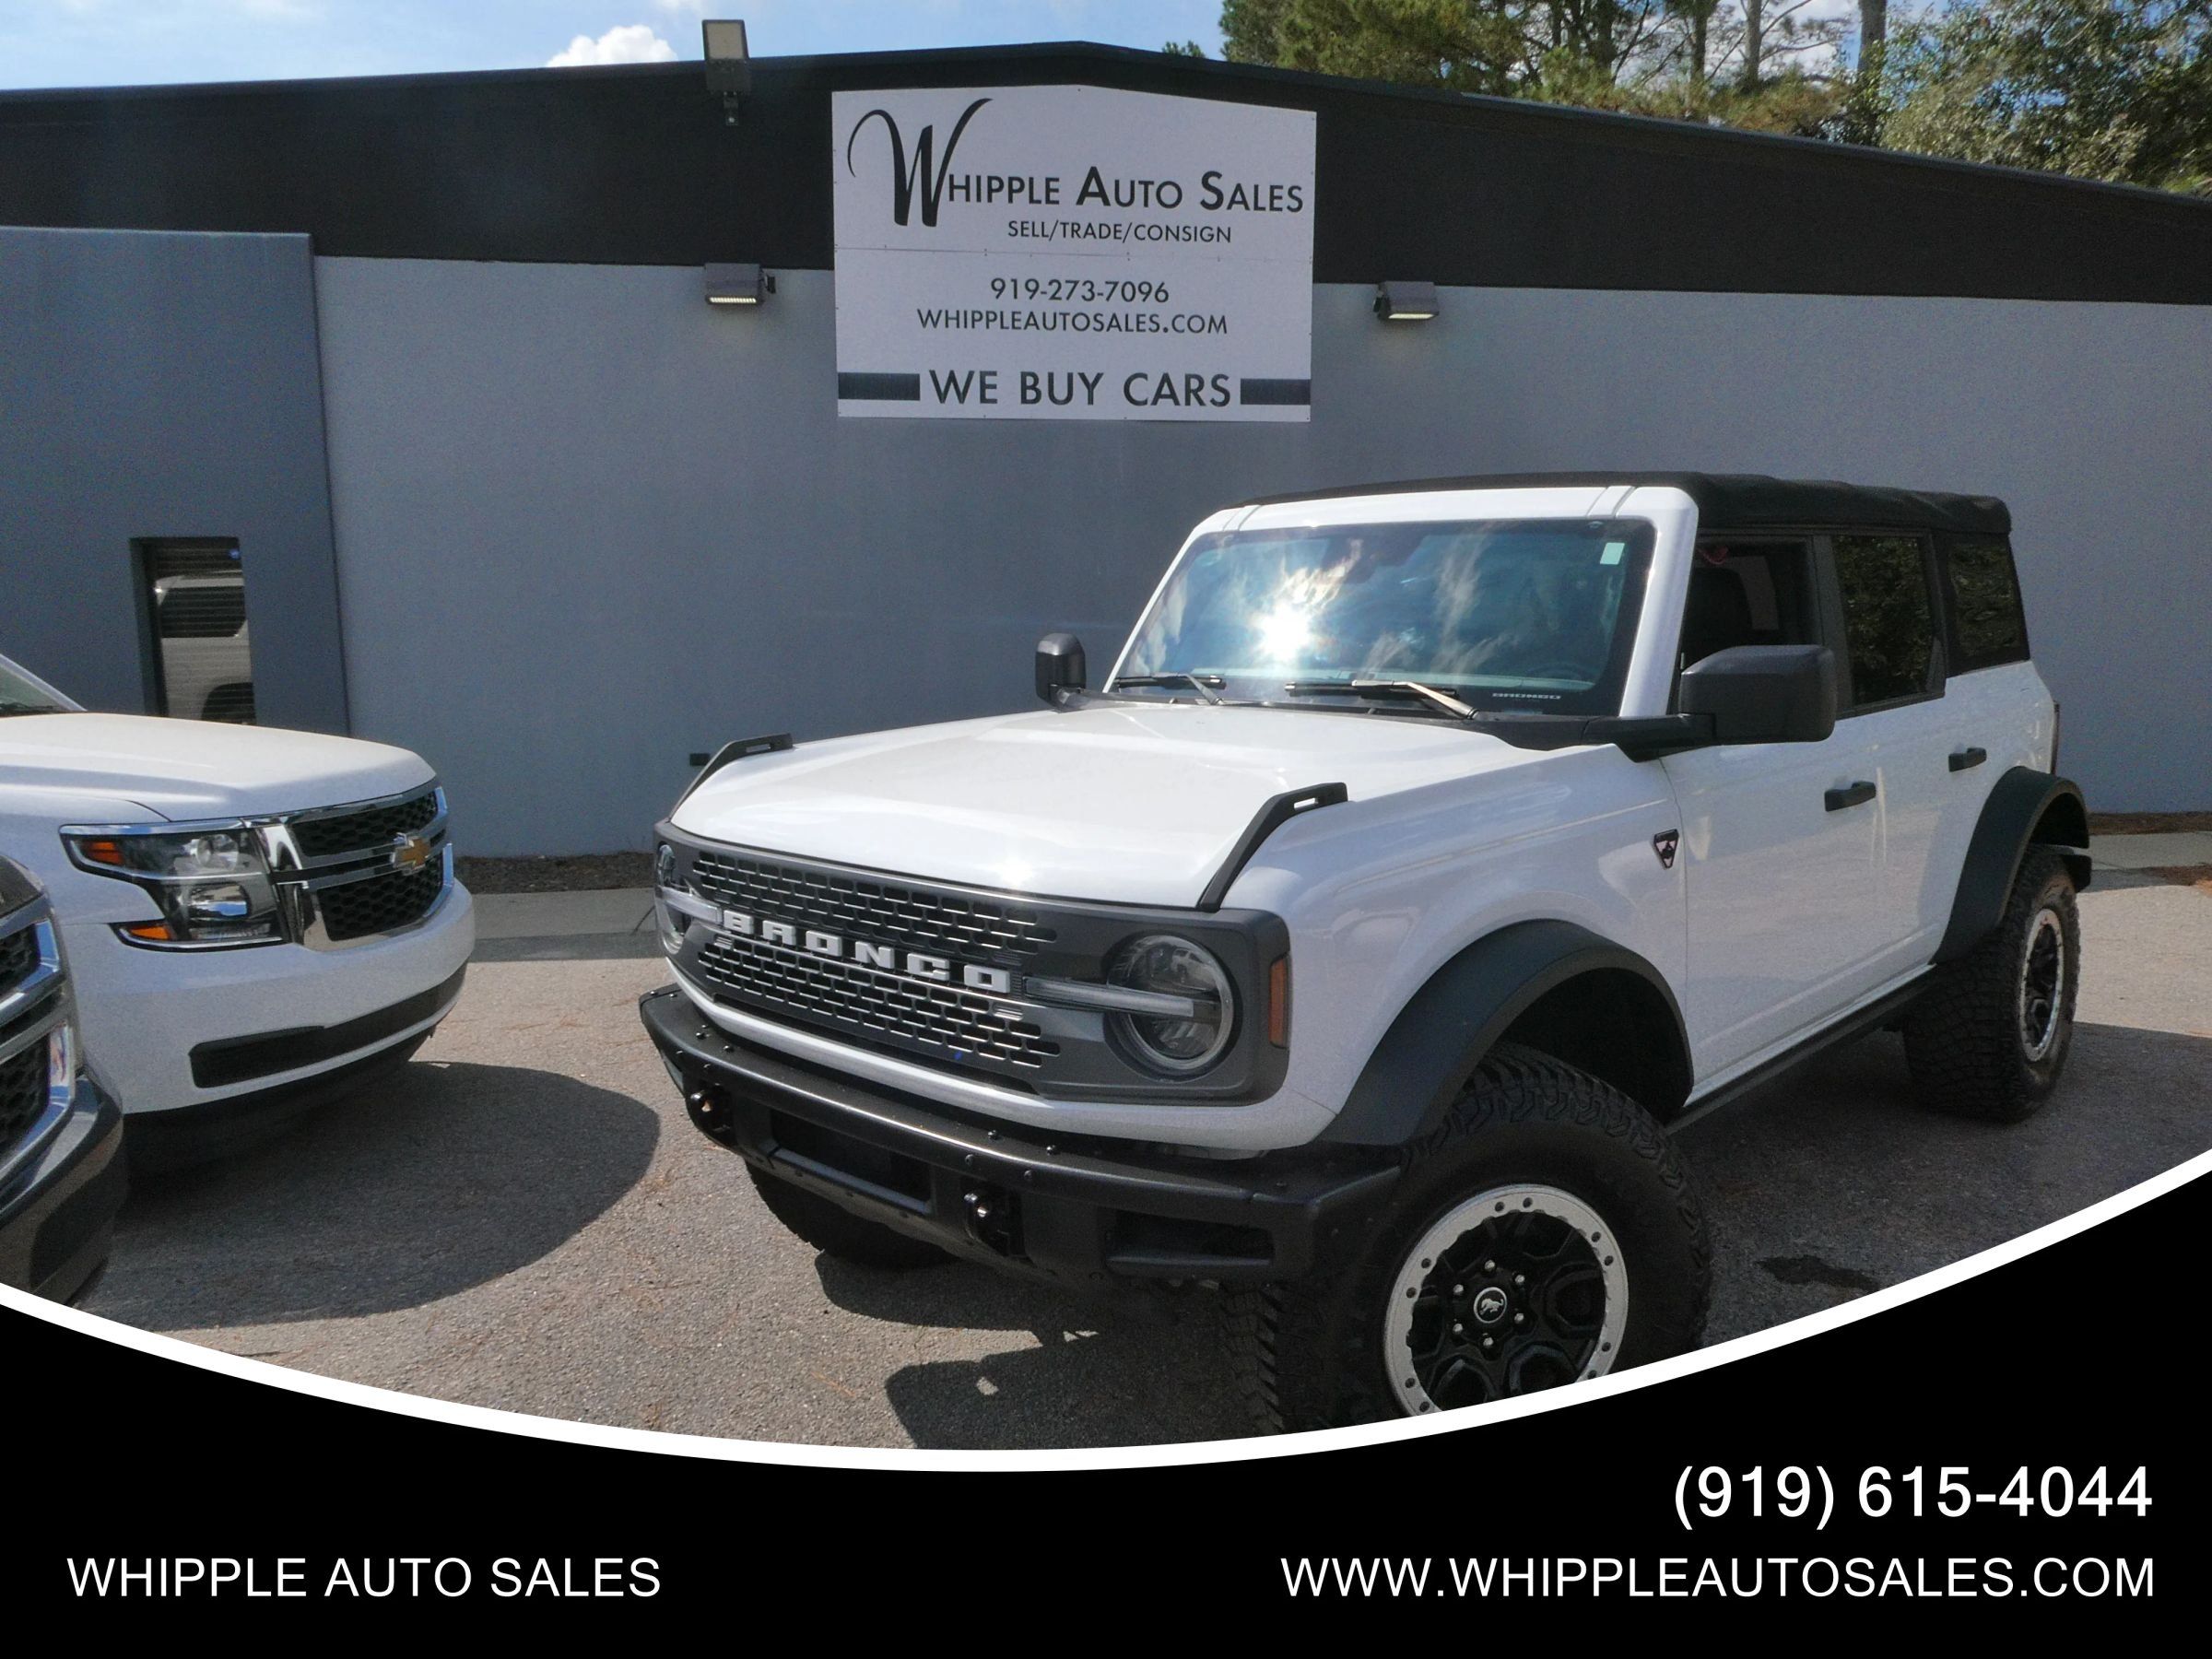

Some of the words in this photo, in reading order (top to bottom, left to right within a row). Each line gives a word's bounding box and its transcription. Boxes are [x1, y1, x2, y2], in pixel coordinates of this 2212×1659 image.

[847, 98, 1061, 228] WHIPPLE
[1076, 166, 1183, 210] AUTO
[1199, 171, 1304, 213] SALES
[1008, 219, 1231, 243] SELL/TRADE/CONSIGN
[991, 277, 1170, 303] 919-273-7096
[917, 308, 1228, 335] WHIPPLEAUTOSALES.COM
[929, 370, 998, 405] WE
[1020, 371, 1104, 406] BUY
[1123, 372, 1231, 407] CARS
[723, 909, 1011, 994] BRONCO
